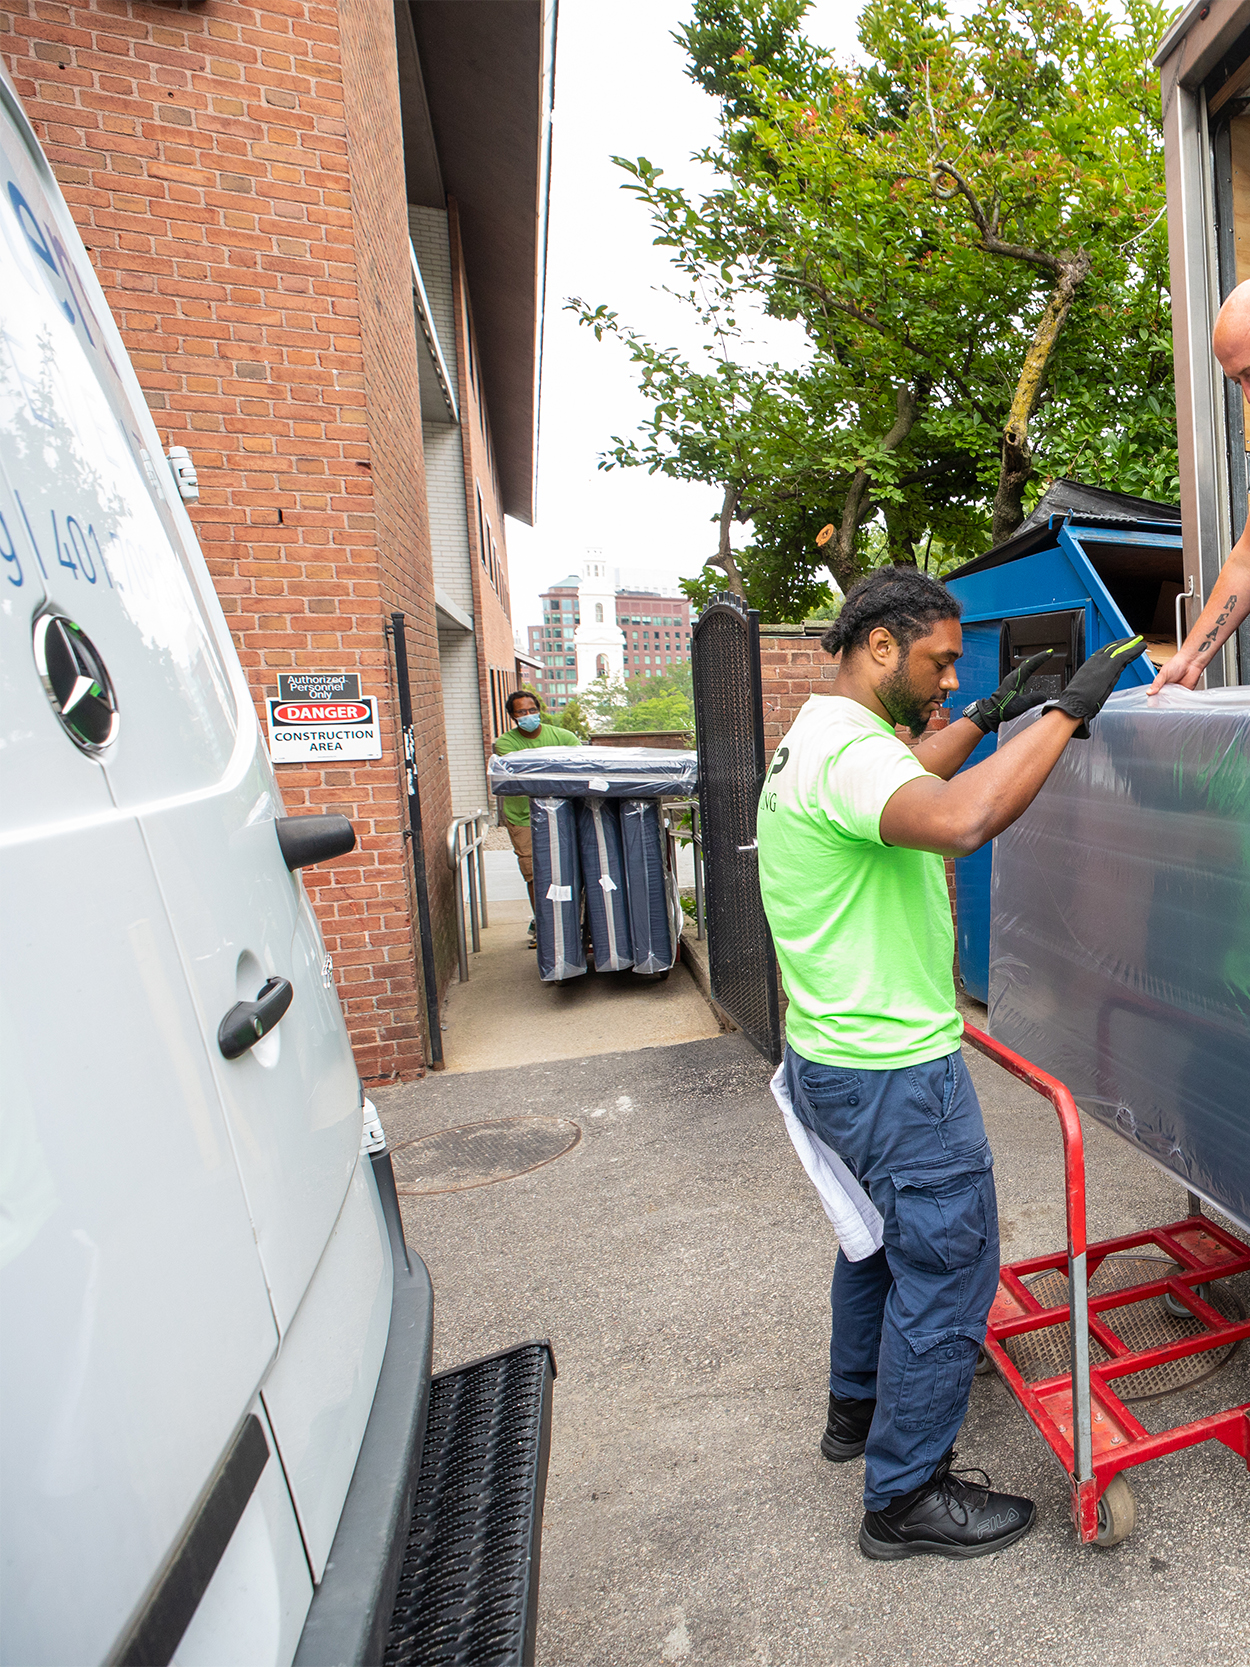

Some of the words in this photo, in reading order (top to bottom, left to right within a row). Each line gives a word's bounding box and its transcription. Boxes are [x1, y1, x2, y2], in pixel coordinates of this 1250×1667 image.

[287, 675, 346, 684] Authorized
[290, 684, 344, 692] Personnel
[309, 690, 333, 700] Only
[286, 706, 358, 719] DANGER
[274, 730, 374, 742] CONSTRUCTION
[309, 742, 343, 751] AREA
[977, 1507, 1020, 1540] FILA
